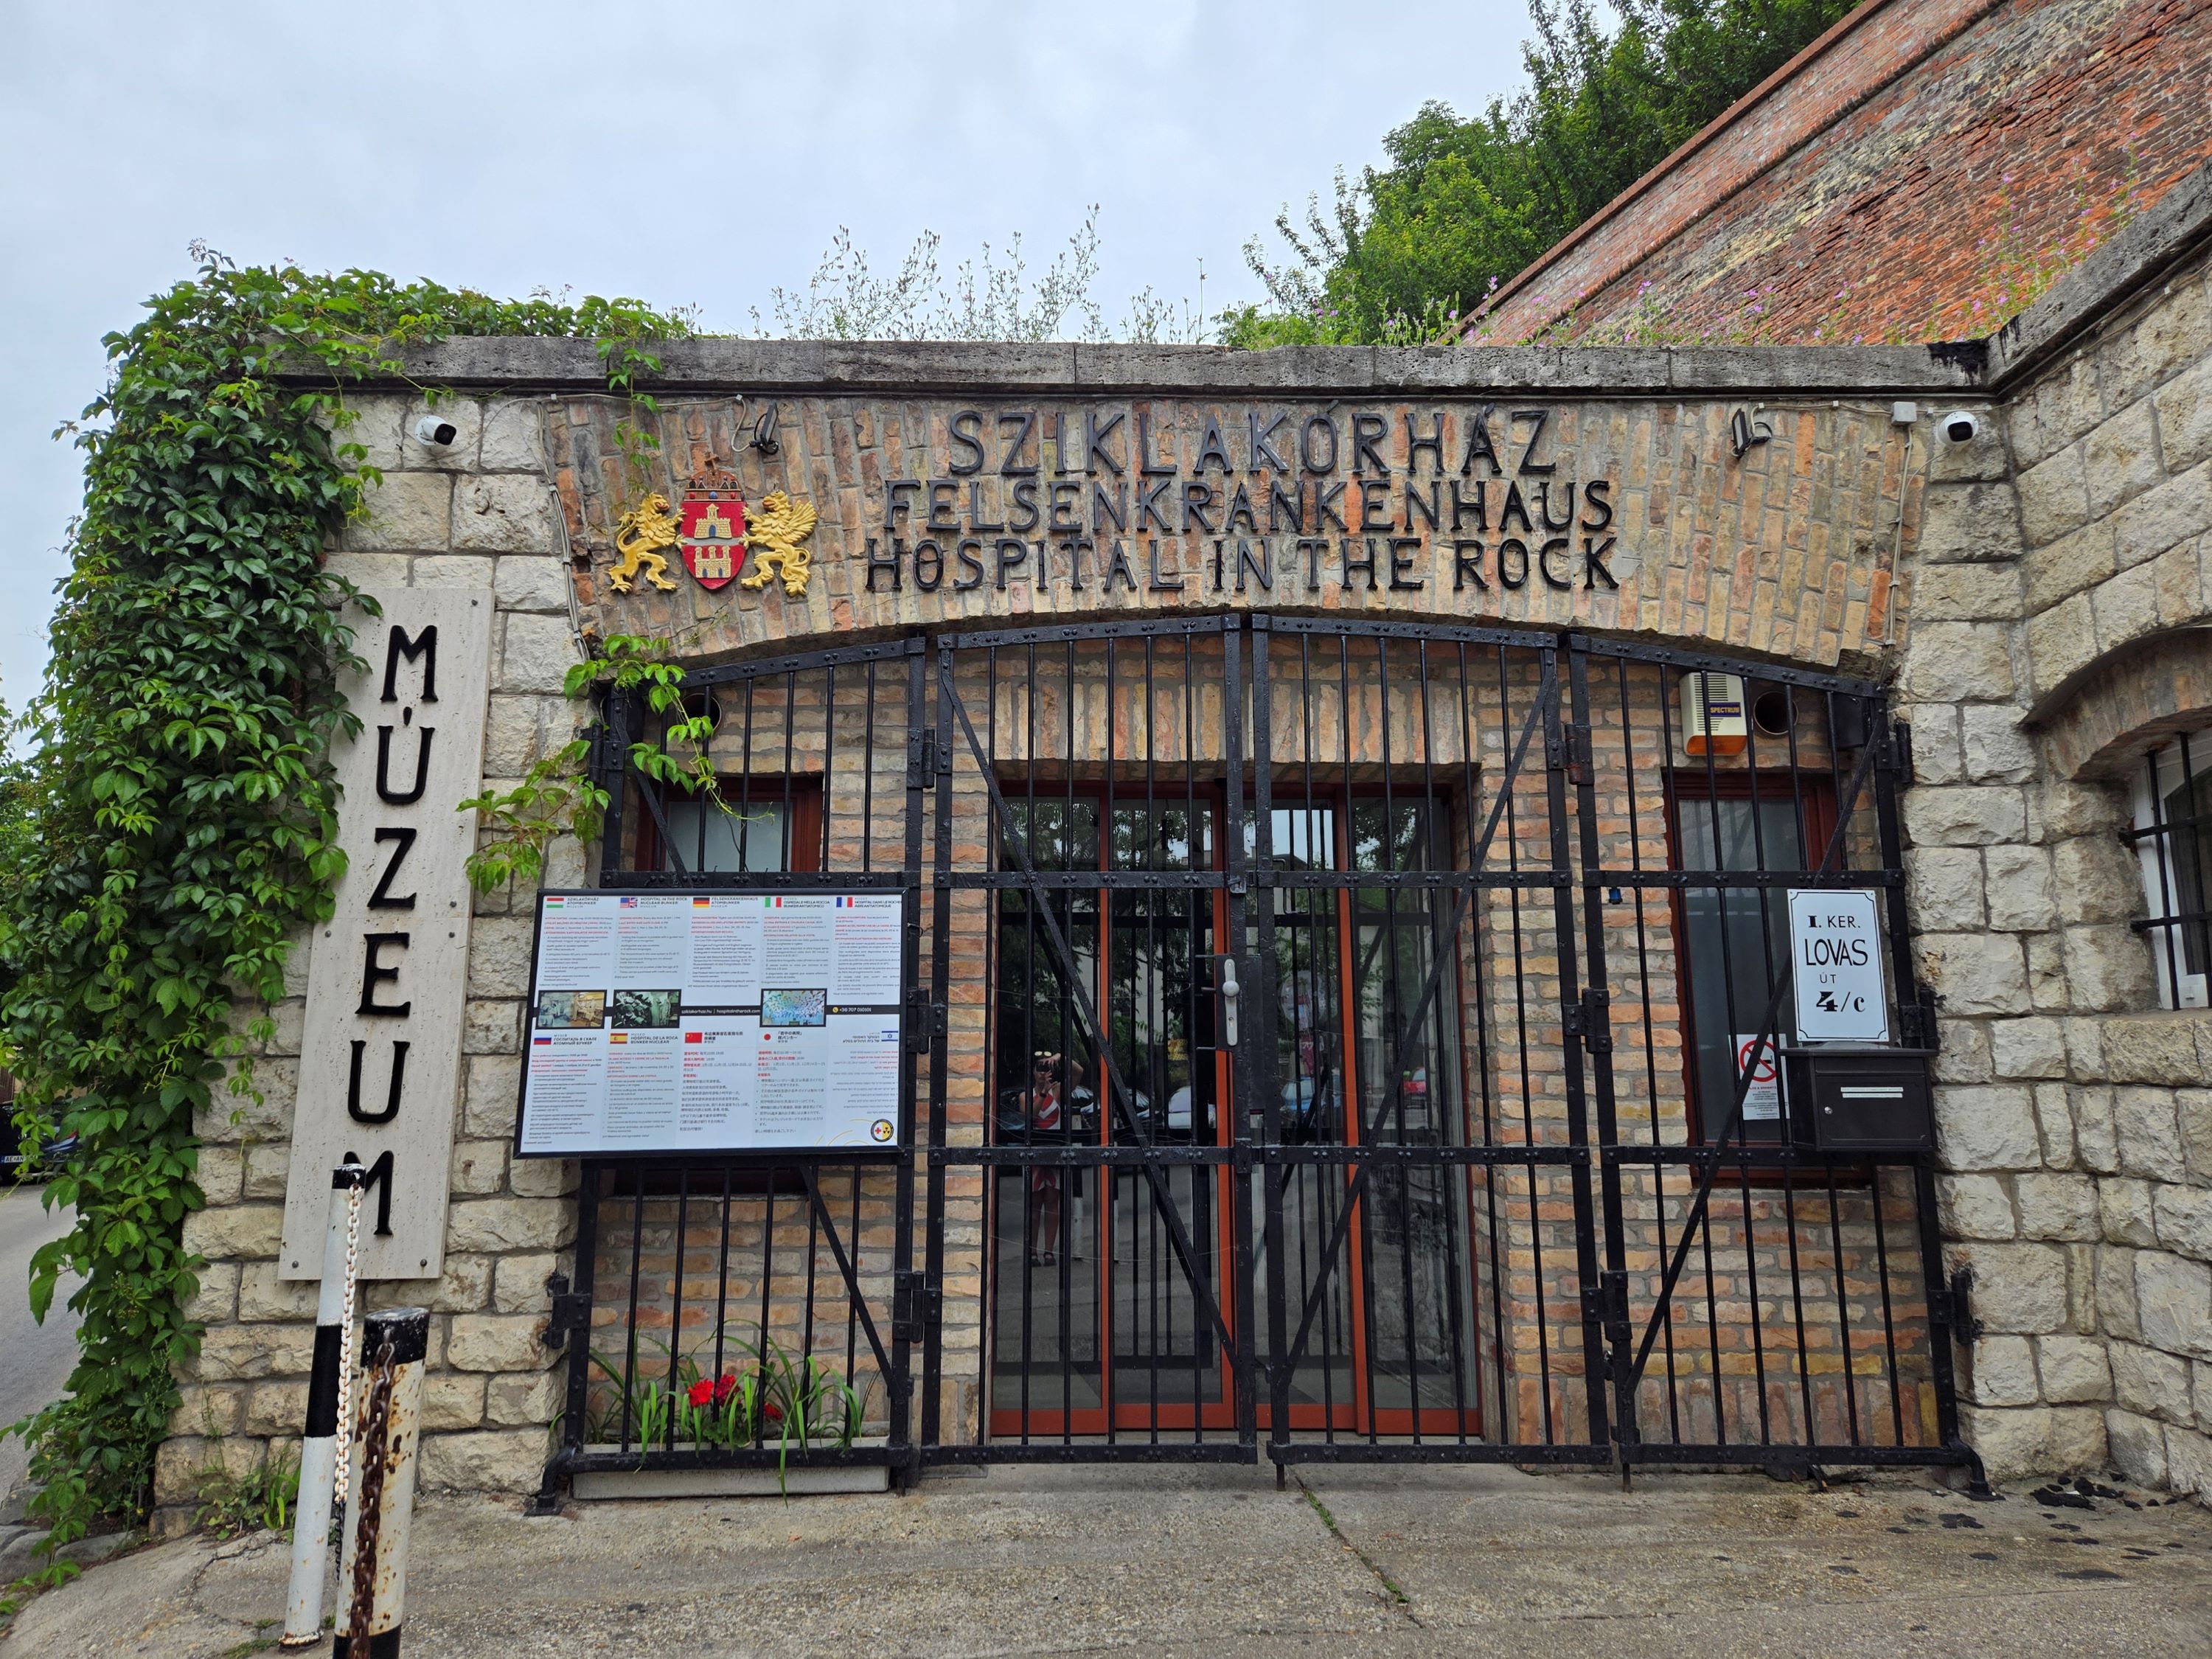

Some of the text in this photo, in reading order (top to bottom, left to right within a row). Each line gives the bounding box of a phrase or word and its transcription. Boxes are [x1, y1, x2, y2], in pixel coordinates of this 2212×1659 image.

[949, 400, 1556, 476] SZIKLAKÓRHÁZ
[886, 479, 1613, 532] FELSENKRANKENHAUS
[866, 535, 1618, 591] HOSPITAL IN THE ROCK
[342, 625, 439, 1237] MÚZEUM
[1808, 915, 1860, 928] I. KER.
[1805, 939, 1868, 966] LOVAS
[1820, 972, 1837, 984] ÚT
